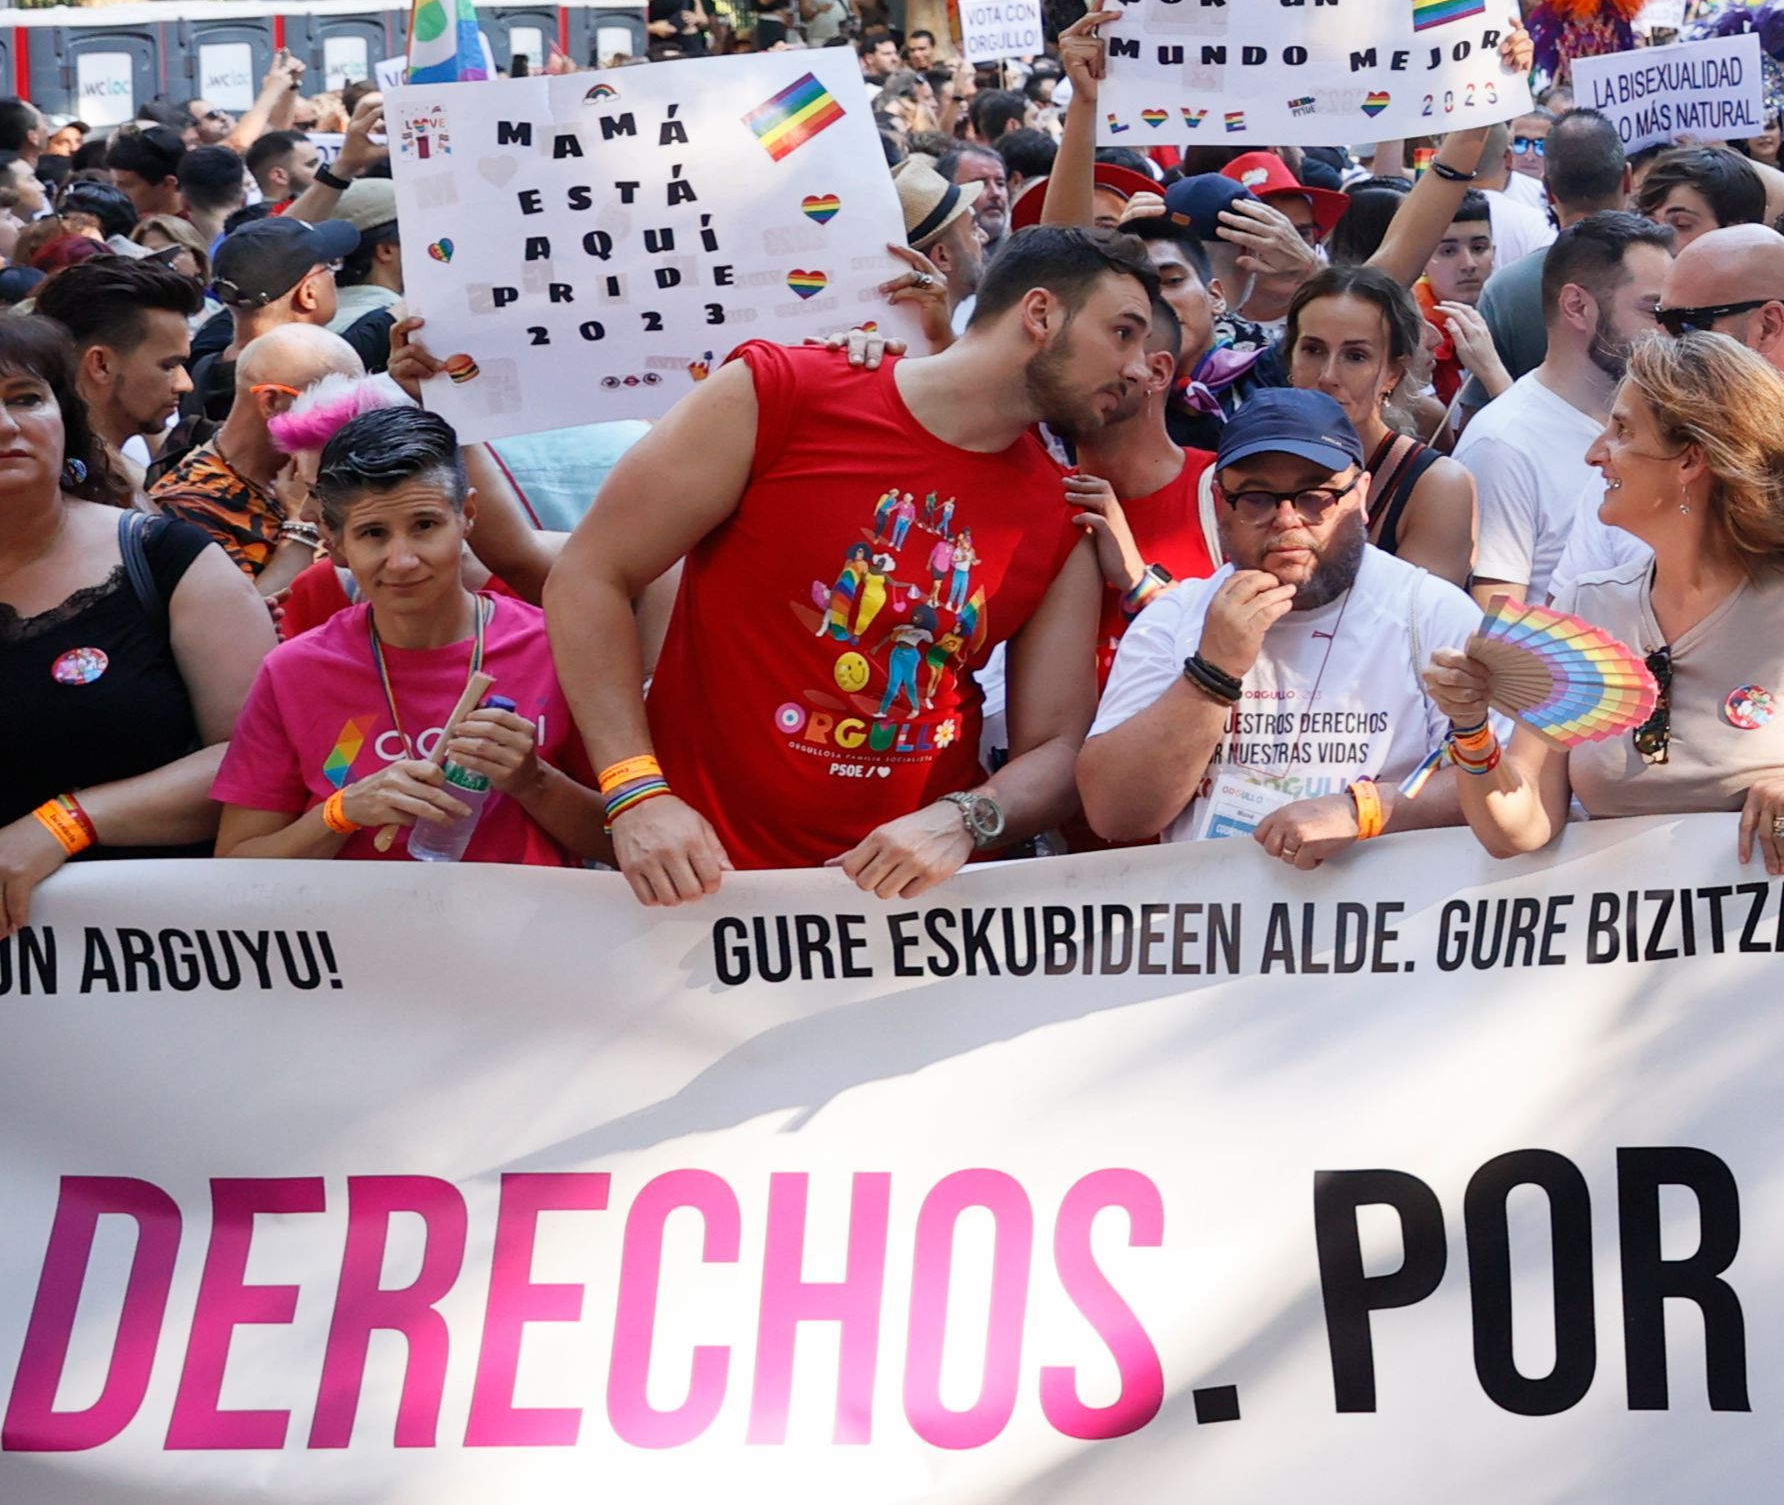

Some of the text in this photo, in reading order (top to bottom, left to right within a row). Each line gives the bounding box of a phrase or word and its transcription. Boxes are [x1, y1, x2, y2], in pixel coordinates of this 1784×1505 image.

[966, 4, 1036, 26] VOTA CON
[1109, 28, 1501, 73] MUNDO MEJOR
[1422, 81, 1499, 117] 2023
[1593, 56, 1743, 109] LA BISEXUALIDAD
[497, 103, 689, 160] MAMÁ
[1619, 98, 1760, 144] O MÁS NATURAL.
[517, 164, 698, 215] ESTÁ
[524, 213, 719, 261] AQUÍ
[492, 264, 735, 308] PRIDE
[527, 301, 726, 345] 2023
[1245, 690, 1295, 700] ORGULLO
[1223, 711, 1389, 734] UESTROS DERECHOS
[788, 741, 842, 759] ORGULLOSA
[829, 762, 864, 778] PSOE
[1228, 742, 1312, 765] NUESTRAS
[1318, 742, 1370, 764] VIDAS
[80, 927, 343, 994] ARGUYU!
[713, 915, 873, 986] GURE
[887, 904, 1241, 977] ESKUBIDEEN
[1261, 902, 1415, 974] ALDE.
[1438, 895, 1575, 972] GURE
[3, 1169, 1241, 1453] DERECHOS.
[1314, 1147, 1752, 1417] POR
